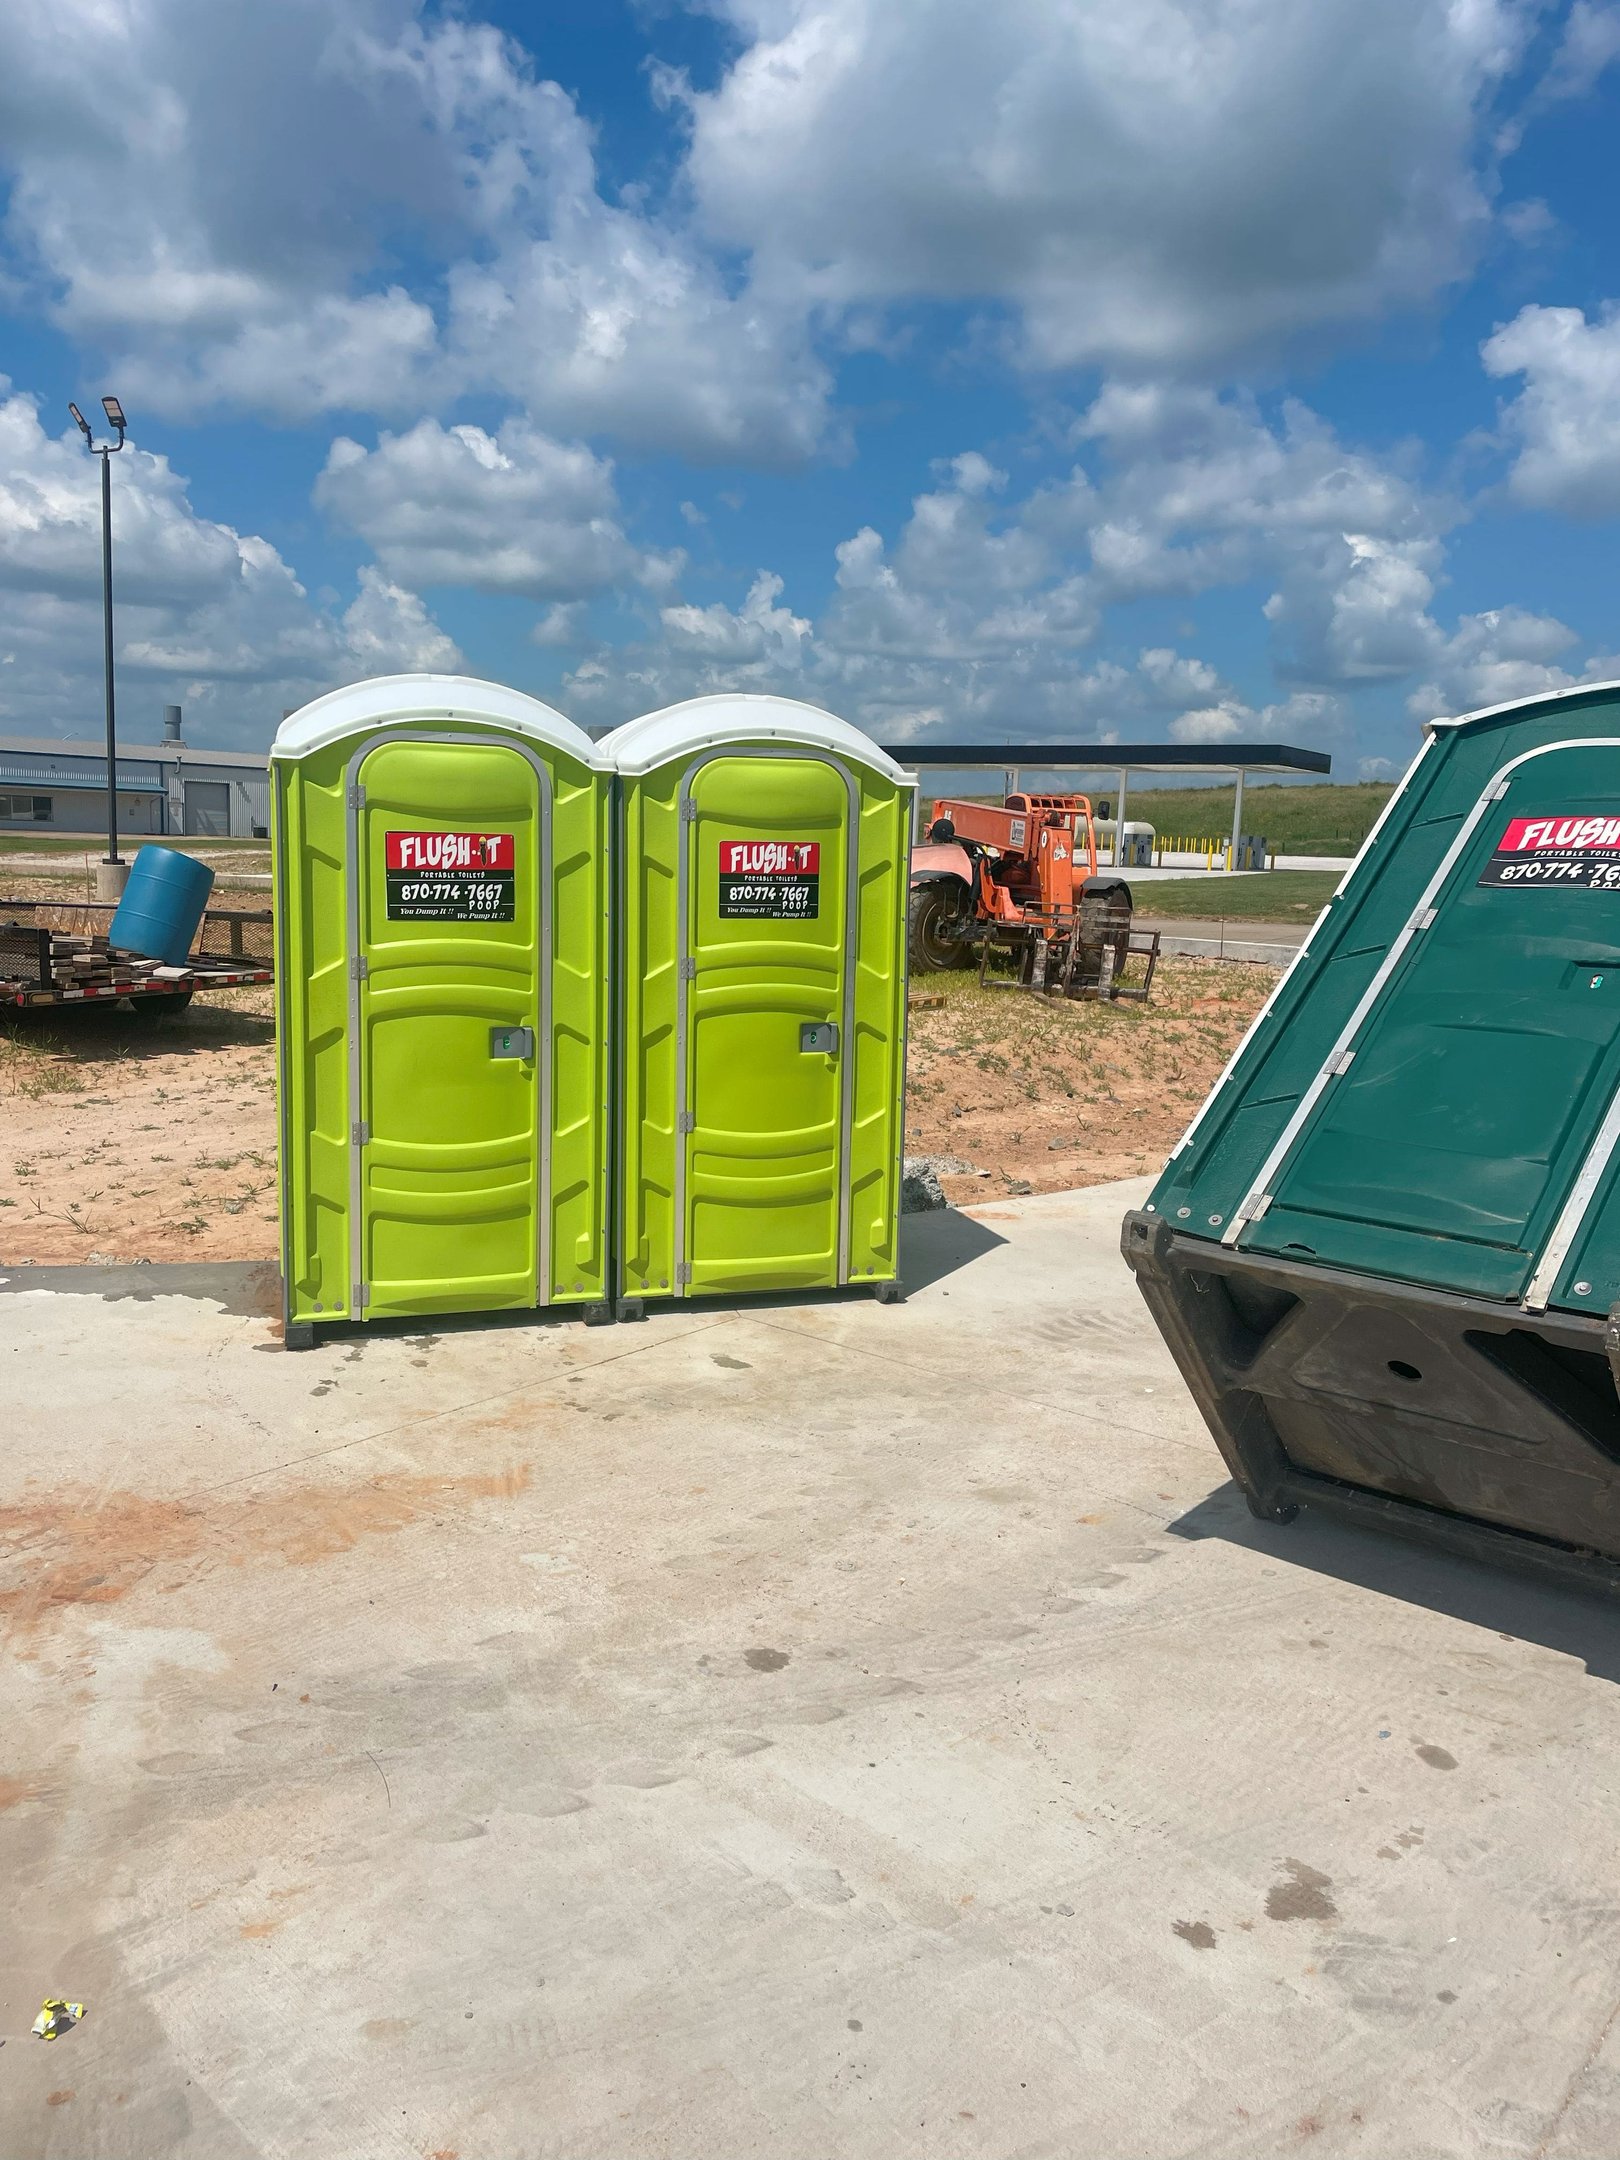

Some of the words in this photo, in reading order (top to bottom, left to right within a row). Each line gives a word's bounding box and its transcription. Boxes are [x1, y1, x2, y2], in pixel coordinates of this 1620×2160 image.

[420, 871, 455, 879] PORTABLE
[458, 871, 486, 879] TOILETS
[468, 900, 500, 910] POOP
[782, 900, 808, 910] POOP
[415, 908, 440, 916] Dump
[457, 912, 468, 920] We
[468, 912, 490, 920] Pump
